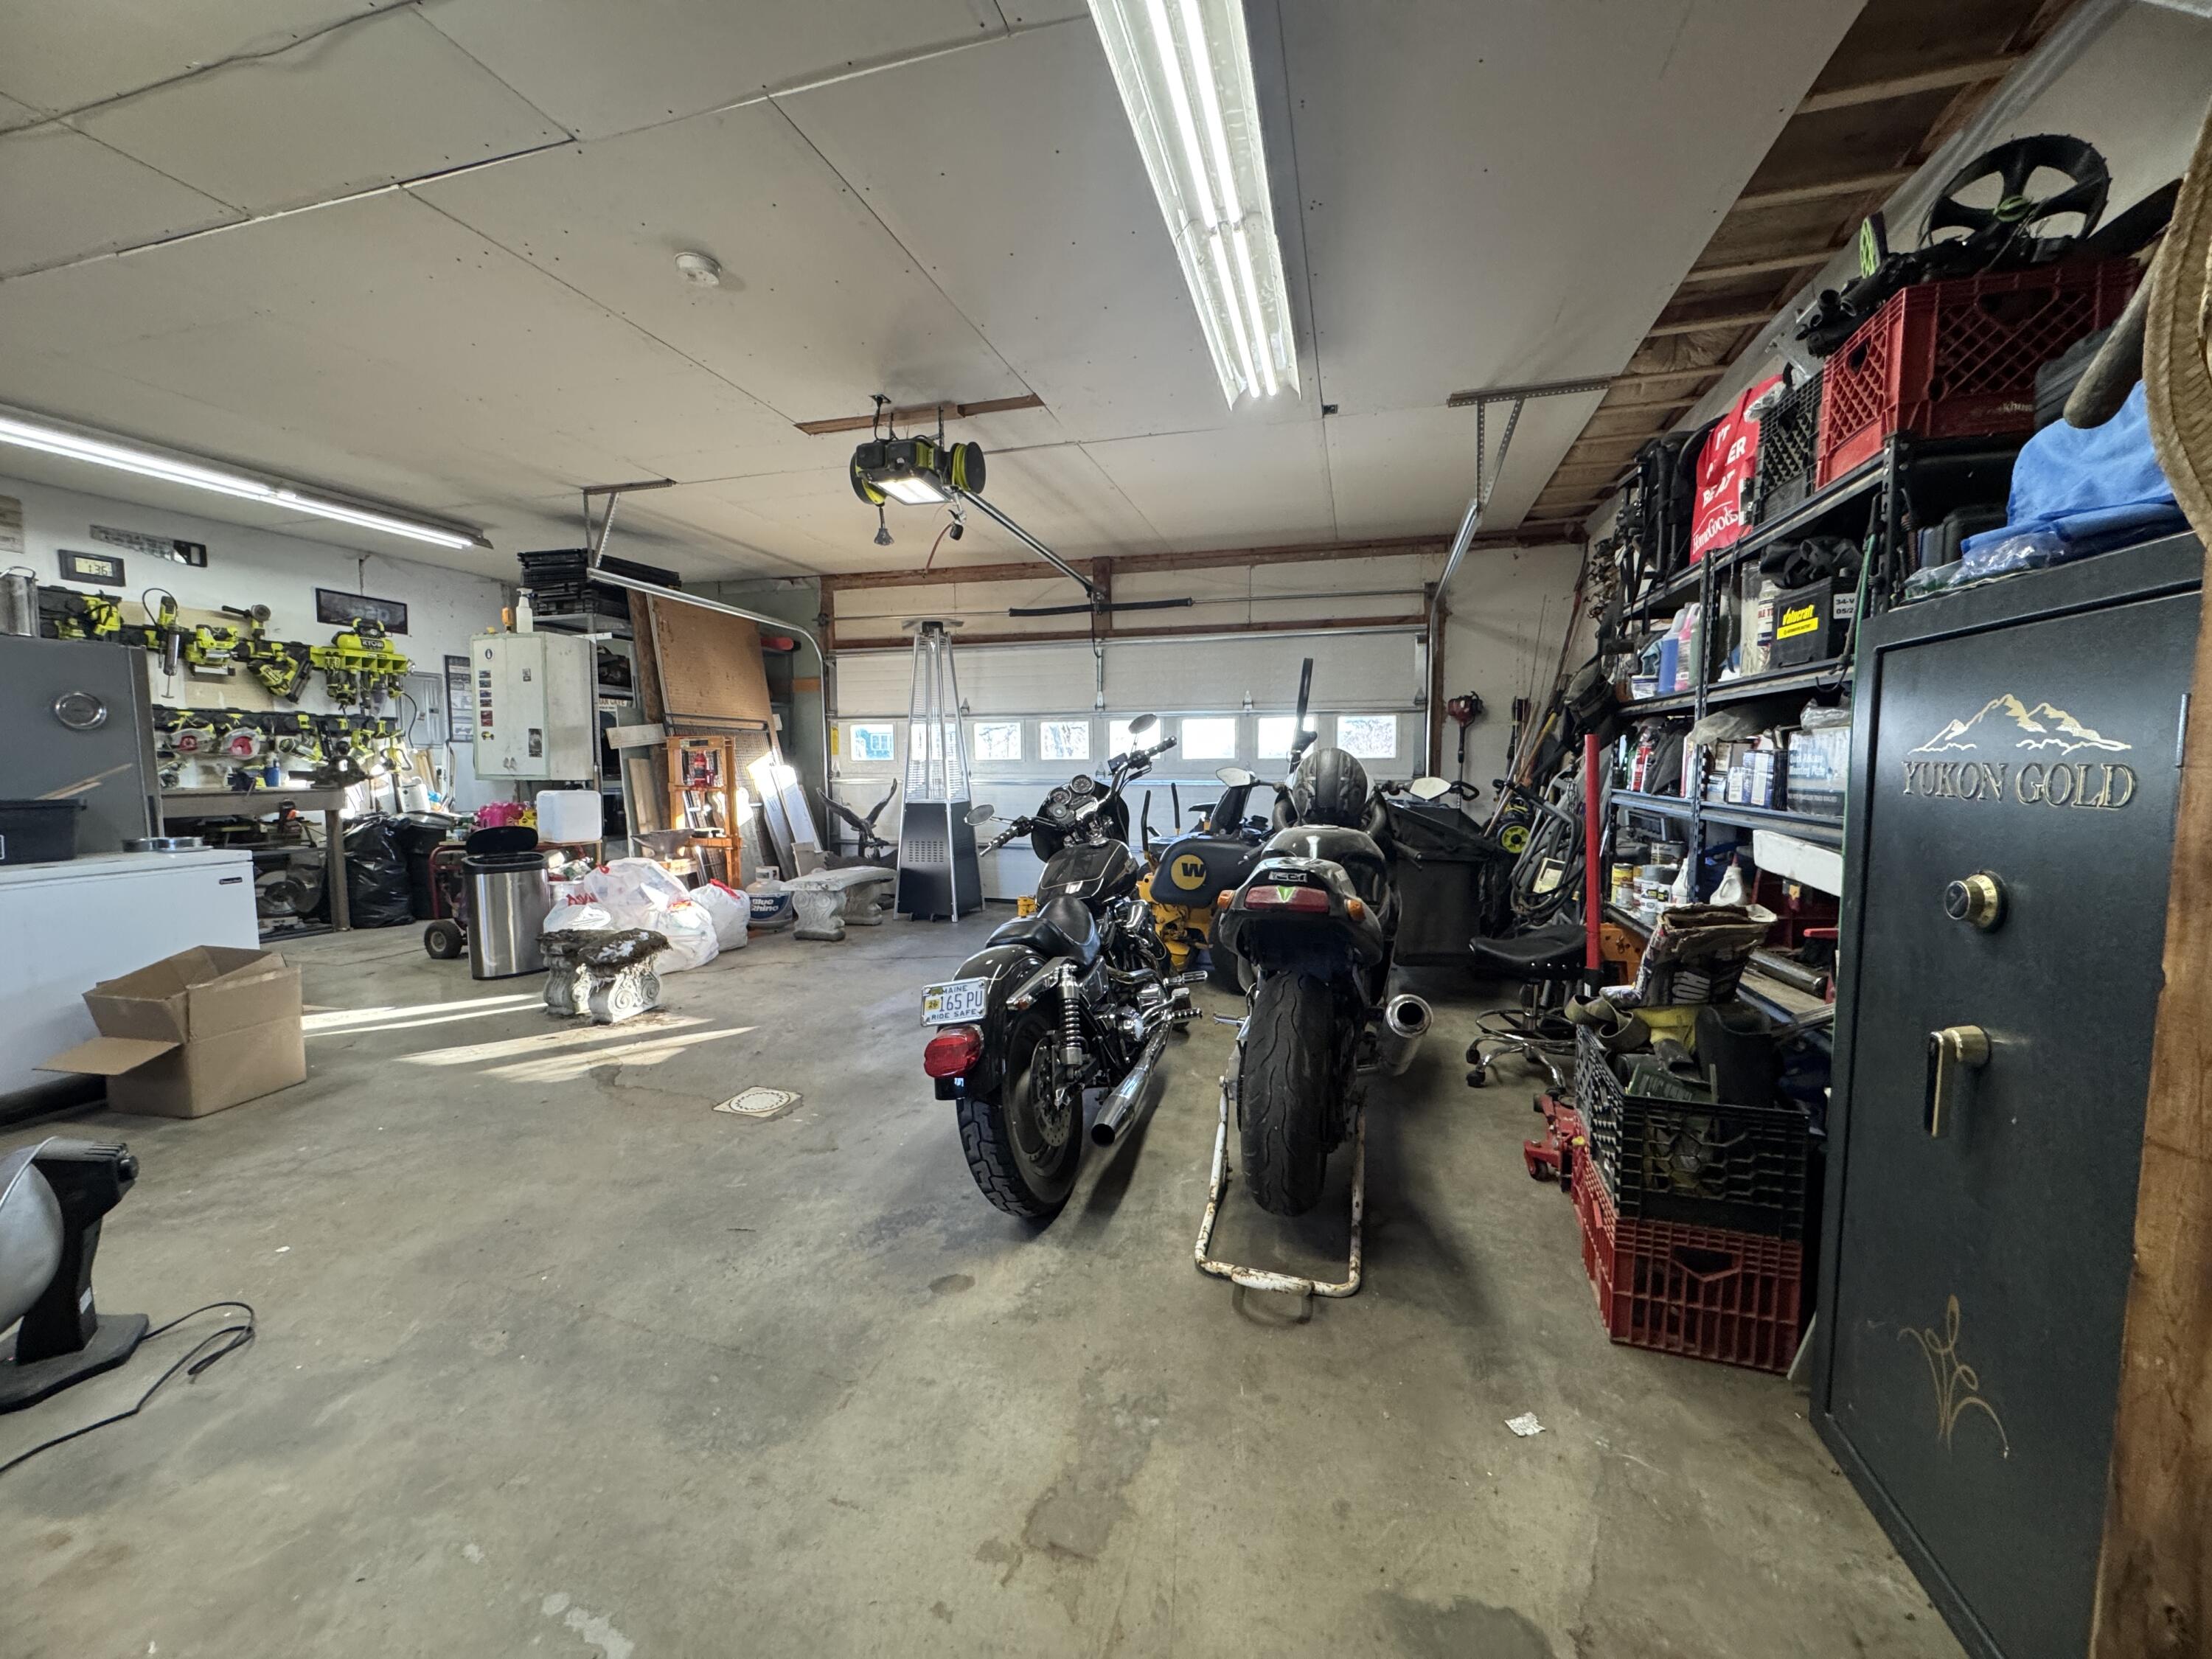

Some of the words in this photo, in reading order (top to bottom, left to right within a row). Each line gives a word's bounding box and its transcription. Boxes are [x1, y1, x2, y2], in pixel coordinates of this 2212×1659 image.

[1692, 506, 1739, 555] HomeGoods
[361, 639, 384, 648] RYOBI
[1901, 760, 2008, 801] YUKON
[2015, 762, 2137, 810] GOLD
[1181, 862, 1207, 877] W
[943, 985, 967, 994] MAINE
[939, 993, 962, 1012] 165
[967, 990, 983, 1008] PU
[931, 1012, 950, 1020] RIDE
[954, 1009, 977, 1018] SAFE
